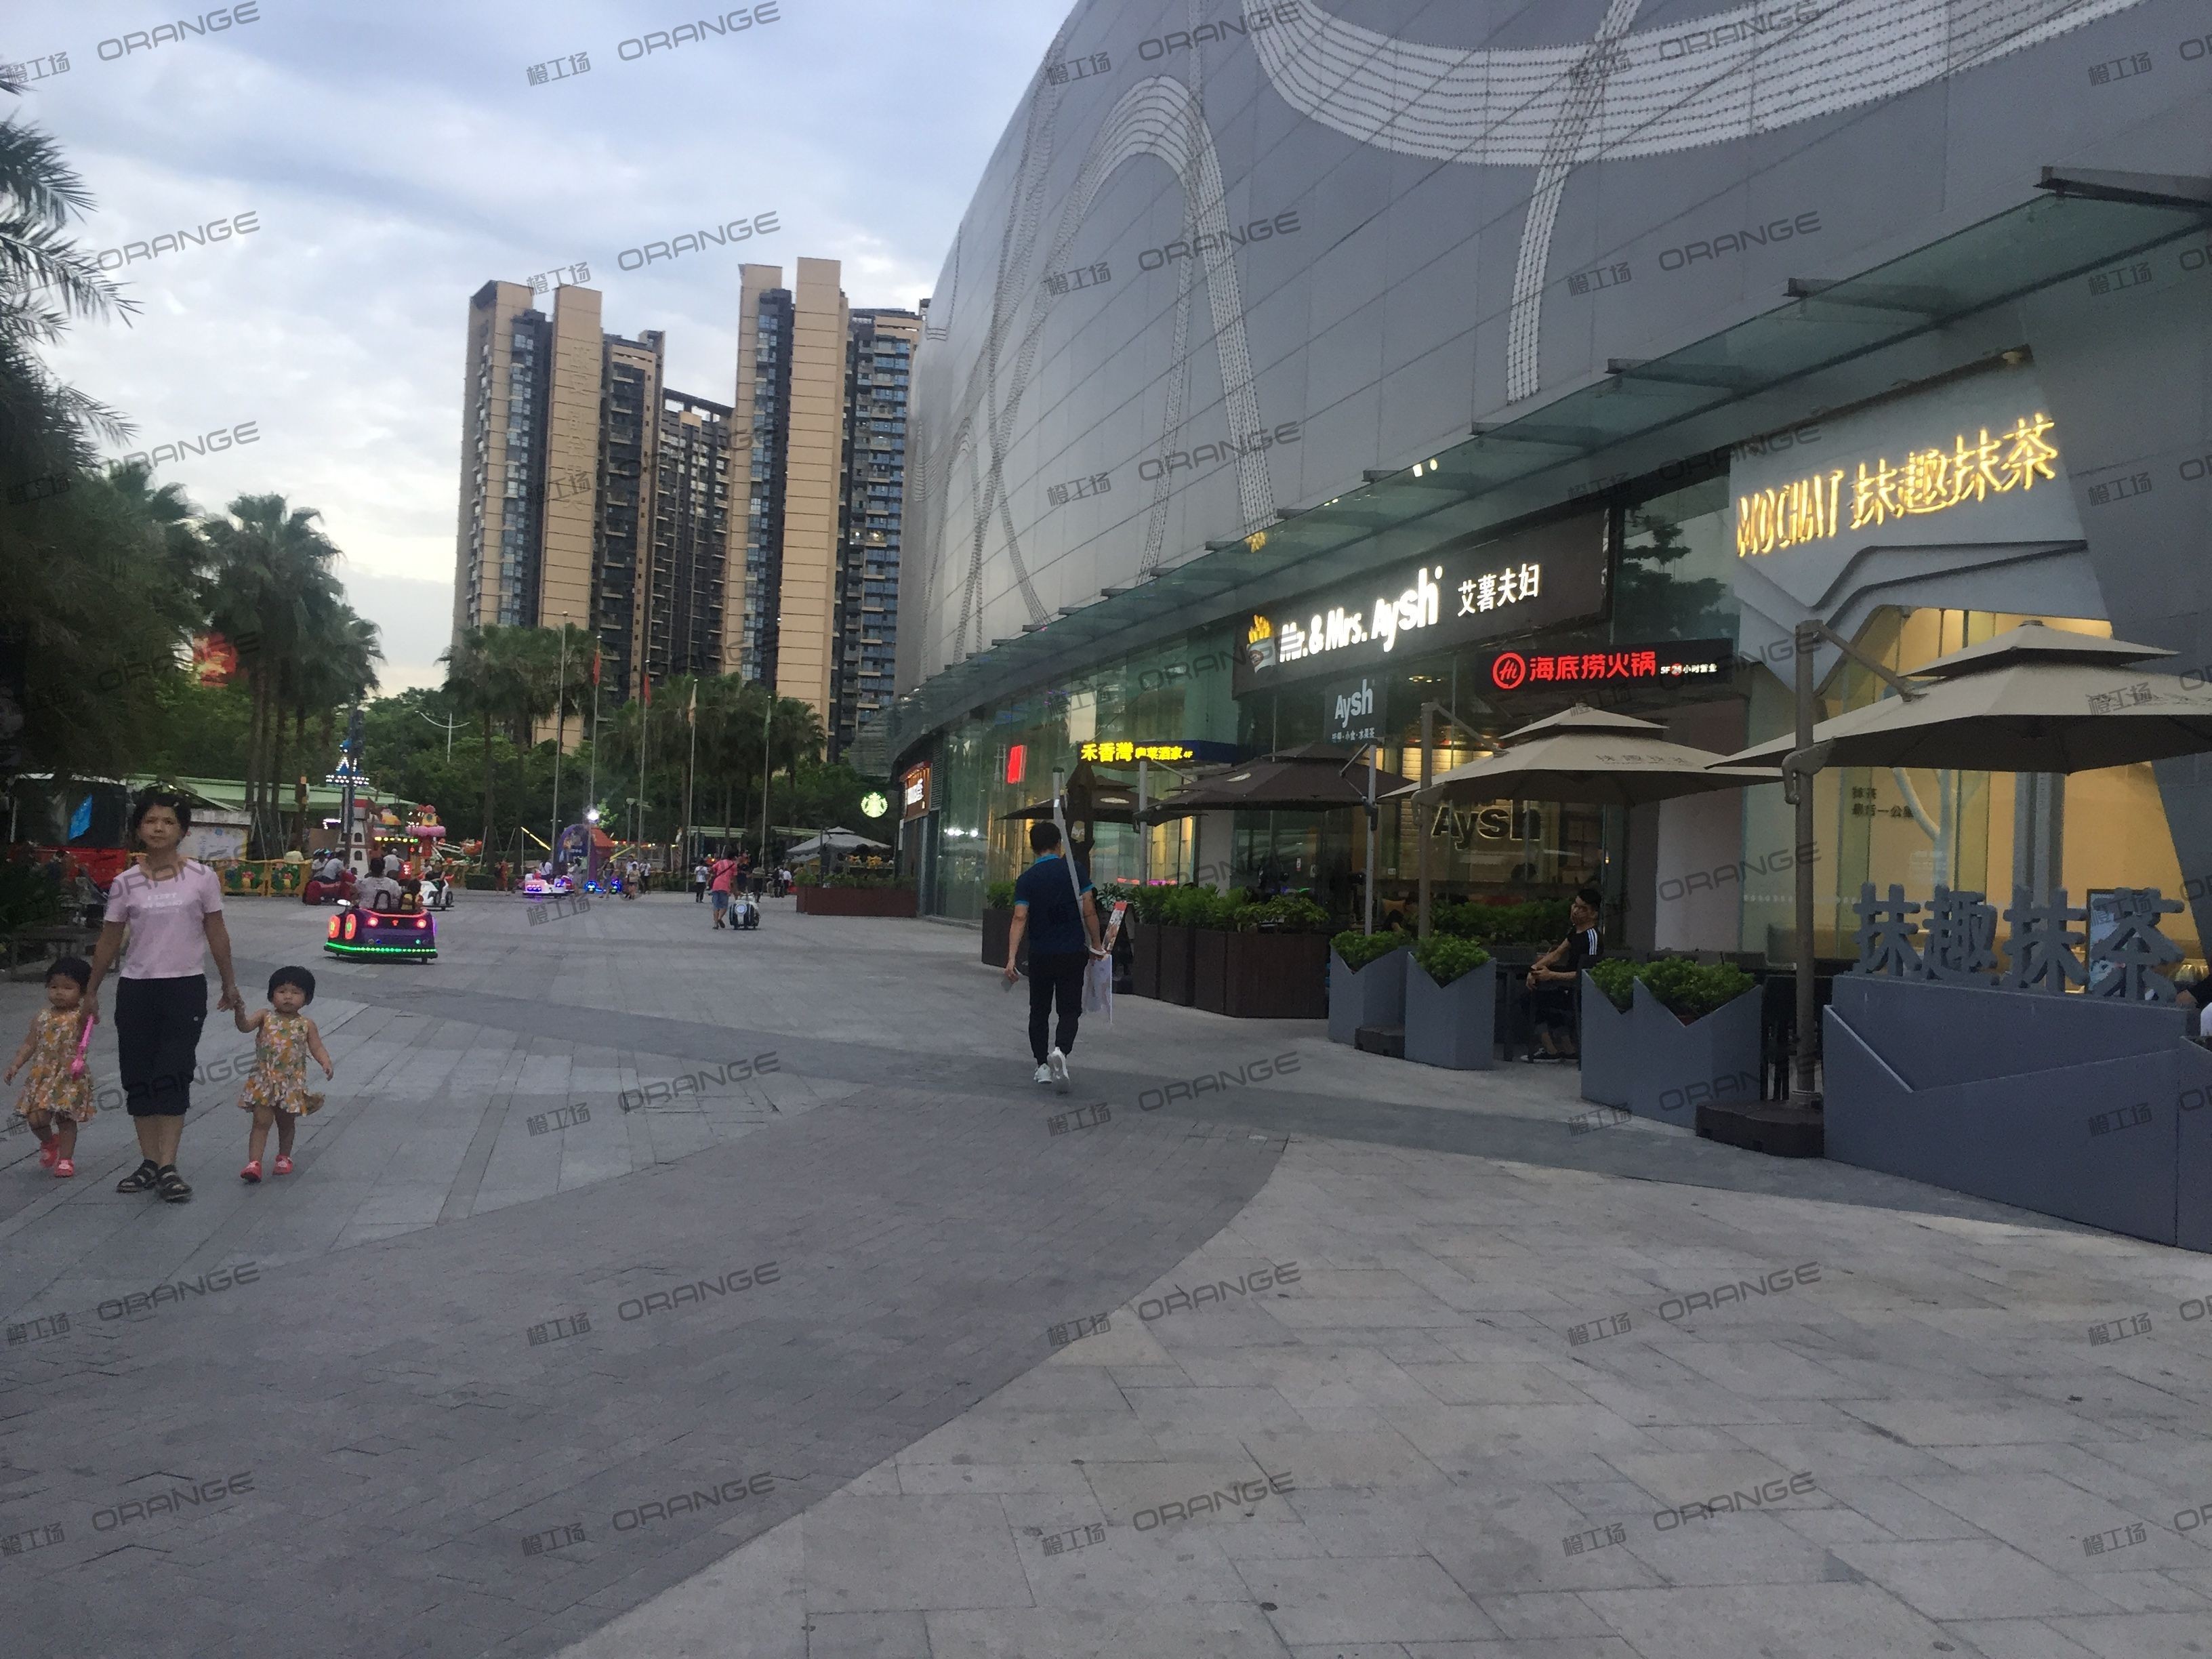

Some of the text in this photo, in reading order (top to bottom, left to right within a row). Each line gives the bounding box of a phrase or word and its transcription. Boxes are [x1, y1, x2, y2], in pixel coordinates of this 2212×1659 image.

[1736, 412, 2059, 558] MOCHAT 抹趣抹茶
[1279, 563, 1540, 663] Mr. & Mrs. Aysh 艾薯夫妇
[1334, 678, 1373, 729] Aysh
[1529, 651, 1656, 682] 海底捞火锅
[1431, 800, 1542, 851] Aysh
[1852, 882, 2186, 1004] 抹趣抹茶
